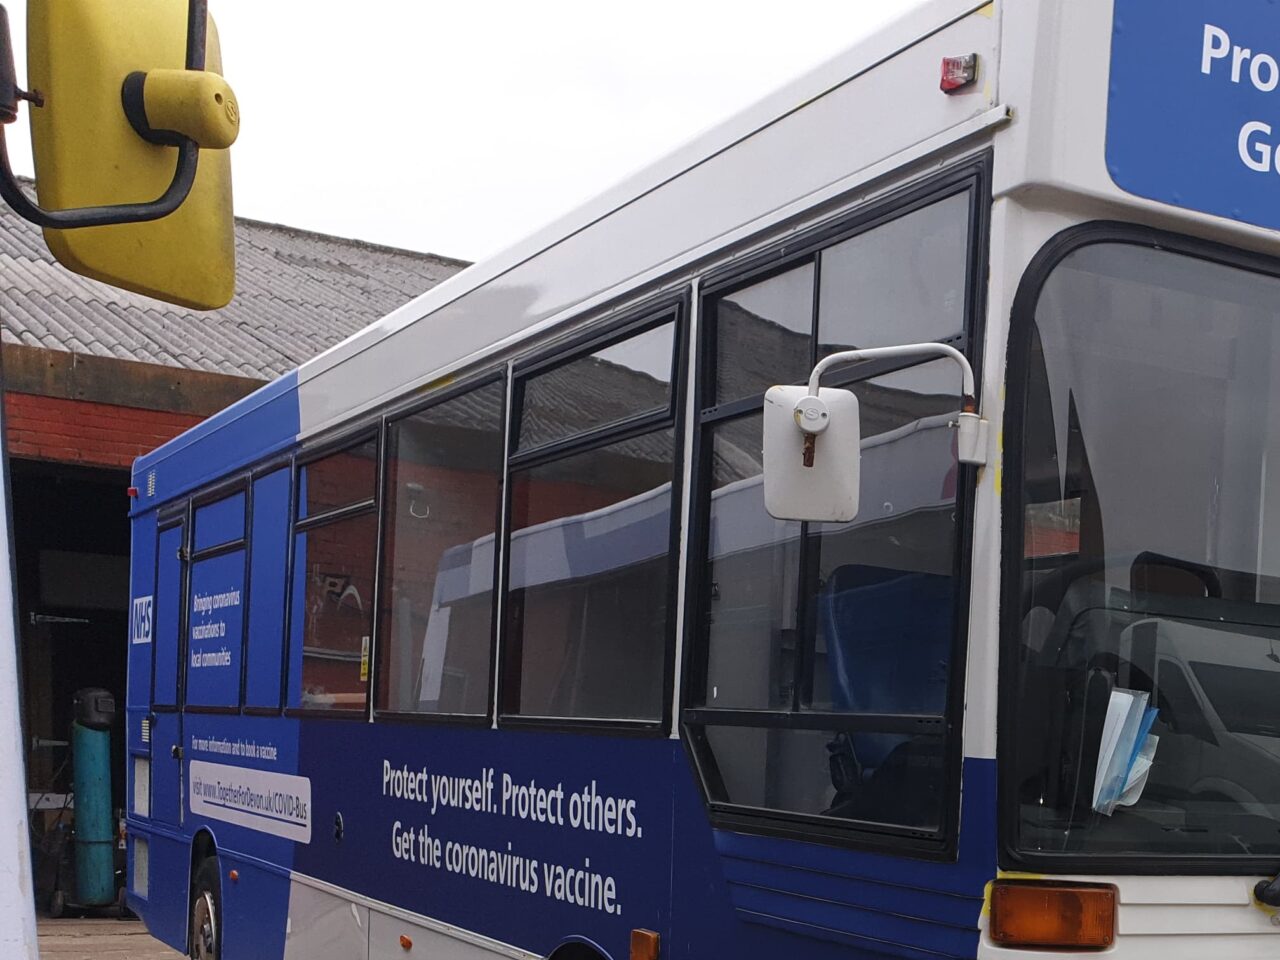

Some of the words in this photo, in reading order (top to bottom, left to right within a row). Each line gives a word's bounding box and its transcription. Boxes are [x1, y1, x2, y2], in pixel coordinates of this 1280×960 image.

[194, 592, 213, 615] Bringing
[213, 586, 240, 609] coronavirus
[133, 599, 152, 640] NHS
[192, 620, 220, 640] vaccinations
[219, 620, 226, 637] to
[191, 648, 202, 667] local
[202, 646, 231, 667] communities
[198, 739, 208, 752] more
[208, 735, 232, 755] information
[231, 738, 240, 756] and
[240, 741, 246, 757] to
[245, 738, 256, 758] book
[259, 741, 277, 760] vaccine
[192, 776, 203, 797] visit
[382, 759, 428, 802] Protect
[431, 767, 497, 815] yourself.
[502, 773, 564, 826] Protect
[568, 780, 643, 838] others.
[392, 820, 416, 863] Get
[418, 824, 442, 868] the
[445, 841, 539, 894] coronavirus
[543, 857, 622, 915] vaccine.
